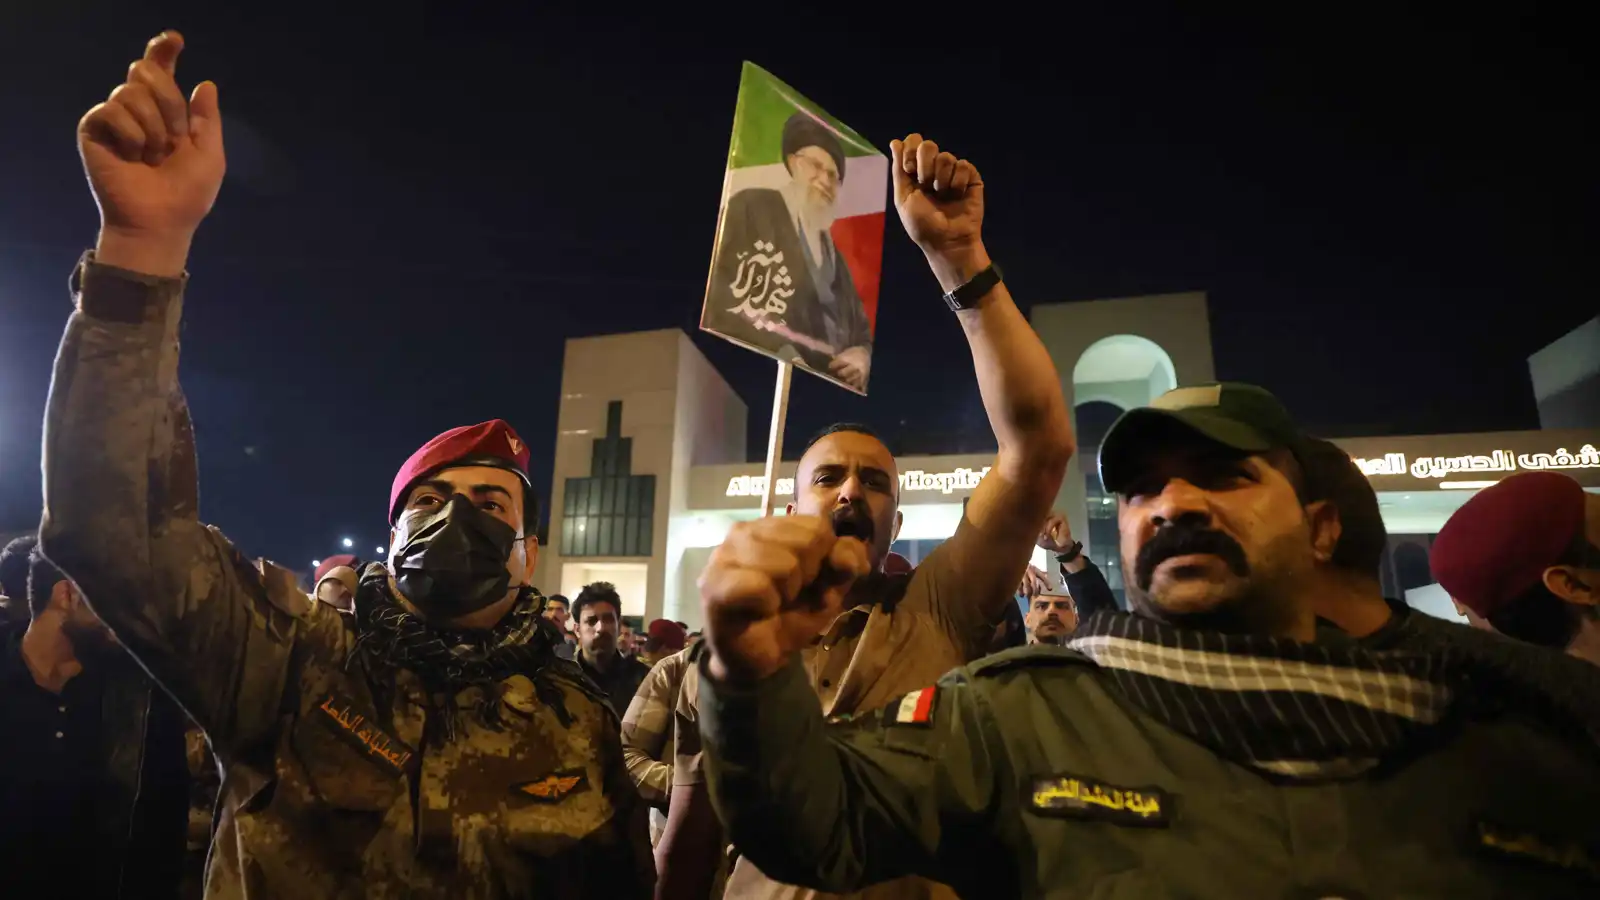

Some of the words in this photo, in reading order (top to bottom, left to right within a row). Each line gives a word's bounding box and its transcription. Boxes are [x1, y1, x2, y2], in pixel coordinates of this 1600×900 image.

[725, 265, 796, 330] شهيد
[1410, 449, 1517, 479] الحسين
[1517, 443, 1600, 470] شفى
[726, 475, 750, 496] Al
